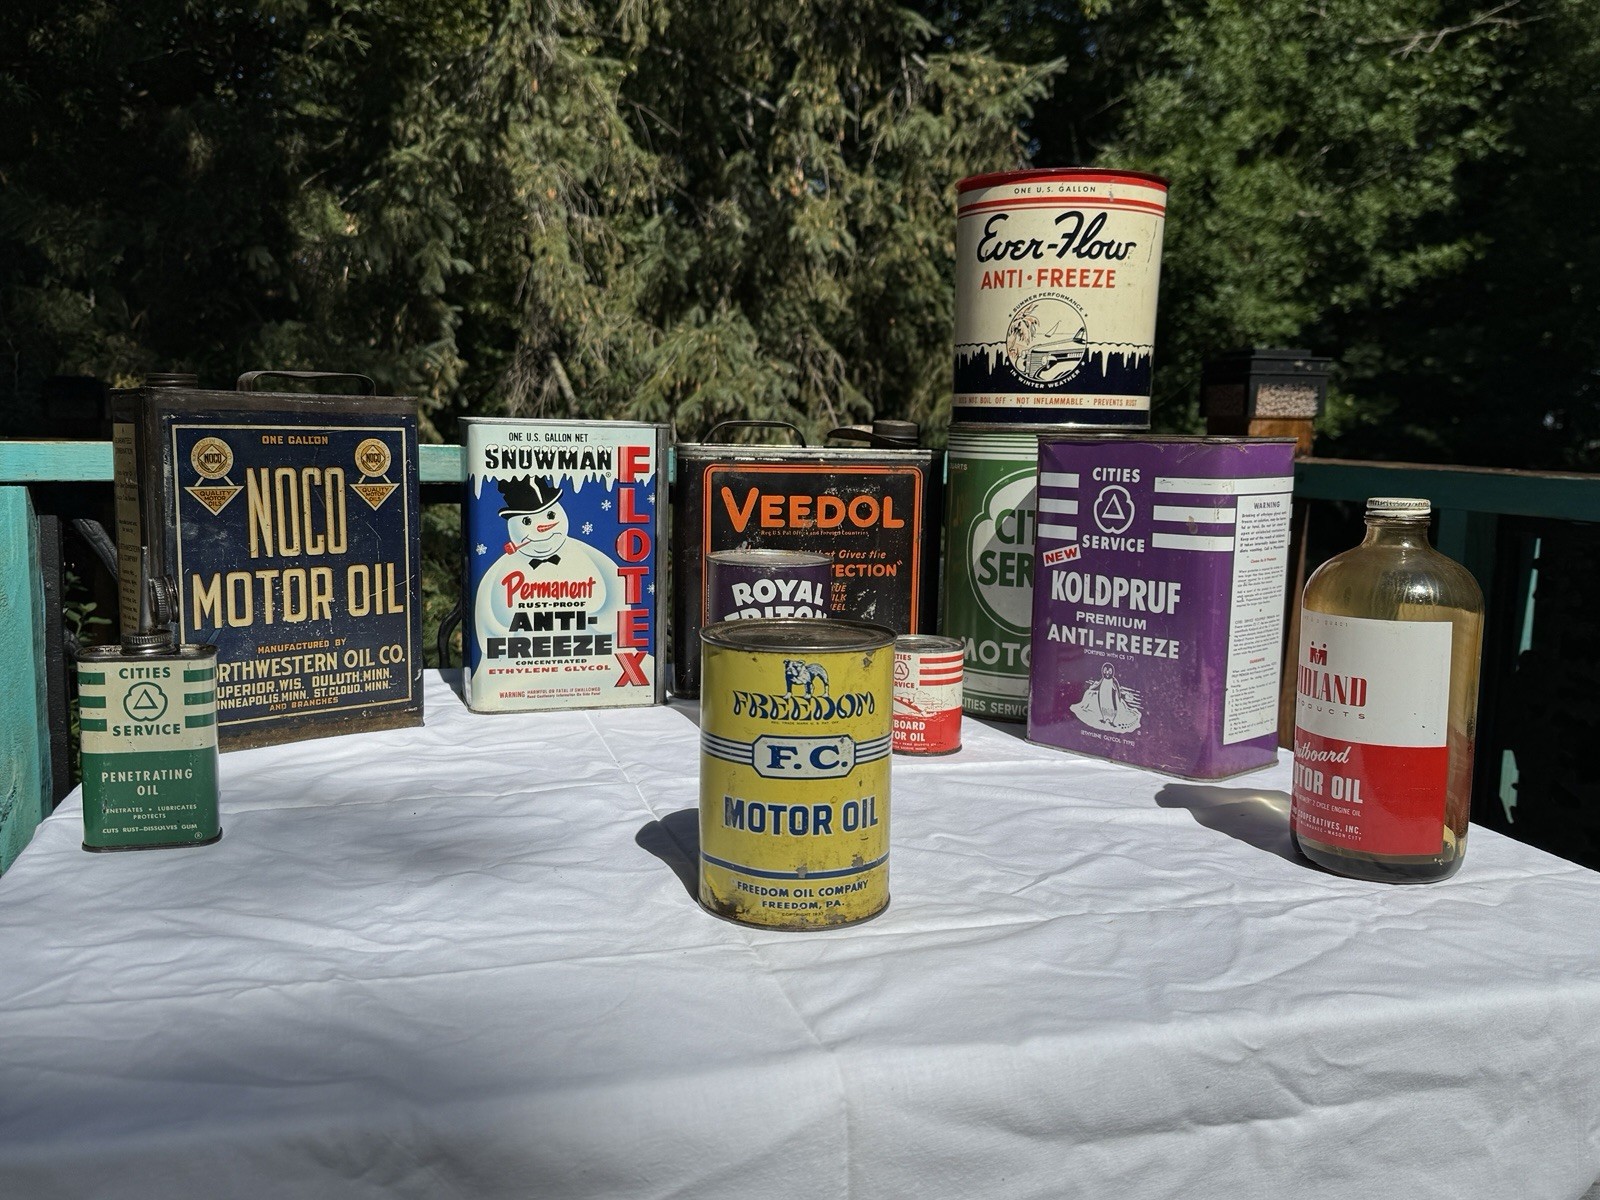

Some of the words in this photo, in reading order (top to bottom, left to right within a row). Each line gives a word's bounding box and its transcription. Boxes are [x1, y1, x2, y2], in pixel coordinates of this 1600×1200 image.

[1014, 186, 1032, 195] ONE
[1059, 185, 1096, 193] GALLON
[977, 210, 1137, 264] Ever-Flow
[1012, 294, 1038, 312] SUMMER
[1038, 292, 1084, 312] PERFORMANCE
[1009, 368, 1017, 377] IN
[1018, 376, 1045, 389] WINTER
[1047, 369, 1081, 389] WEATHER
[995, 396, 1006, 405] OFF
[1015, 396, 1029, 405] NOT
[1033, 397, 1083, 405] INFLAMMABLE
[1093, 398, 1123, 407] PREVENTS
[262, 435, 284, 445] ONE
[287, 435, 329, 446] GALLON
[508, 432, 523, 441] ONE
[526, 433, 541, 442] U.S.
[544, 433, 572, 442] GALLON
[574, 433, 589, 443] NET
[204, 453, 222, 464] NOCO
[485, 444, 612, 470] SNOWMAN
[1092, 467, 1141, 483] CITIES
[246, 466, 348, 559] NOCO
[721, 486, 905, 533] VEEDOL
[1253, 501, 1281, 510] WARNING
[995, 508, 1036, 545] CIT
[1082, 534, 1145, 553] SERVICE
[839, 549, 867, 559] Gives
[869, 549, 887, 559] the
[1045, 547, 1078, 564] NEW
[614, 446, 652, 688] FLOTEX
[832, 559, 902, 578] ECTION"
[192, 566, 335, 631] MOTOR
[347, 562, 404, 617] OIL
[501, 570, 597, 608] Permanent
[731, 578, 824, 607] ROYAL
[1051, 569, 1182, 615] KOLDPRUF
[517, 601, 587, 609] RUST-PROOF
[508, 611, 598, 632] ANTI-
[1076, 611, 1147, 630] PREMIUM
[257, 640, 330, 654] MANUFACTURED
[334, 637, 347, 647] BY
[487, 634, 613, 660] FREEZE
[1047, 623, 1180, 660] ANTI-FREEZE
[895, 653, 912, 661] TIES
[961, 636, 1032, 667] MOTO
[216, 651, 338, 684] RTHWESTERN
[343, 647, 376, 669] OIL
[378, 643, 406, 665] CO.
[488, 667, 559, 675] ETHYLENE
[564, 665, 611, 673] GLYCOL
[515, 658, 588, 666] CONCENTRATED
[118, 666, 171, 680] CITIES
[893, 681, 915, 689] RVICE
[1298, 664, 1367, 707] IDLAND
[500, 690, 525, 699] WARNING
[269, 702, 288, 712] AND
[291, 696, 339, 709] BRANCHES
[733, 690, 875, 721] FREEDOM
[990, 701, 1029, 717] SERVIC
[1298, 697, 1365, 720] ODUCTS
[112, 723, 181, 737] SERVICE
[892, 719, 926, 730] BOARD
[909, 732, 926, 742] OIL
[1103, 734, 1122, 744] GLYCOL
[101, 768, 193, 783] PENETRATING
[1294, 760, 1324, 796] OTOR
[1331, 775, 1364, 804] OIL
[136, 784, 159, 796] OIL
[104, 806, 143, 815] ENETRATES
[157, 803, 197, 812] LUBRICATES
[132, 813, 167, 821] PROTECTS
[723, 796, 834, 837] MOTOR
[842, 795, 879, 833] OIL
[1316, 801, 1331, 811] CYCLE
[1331, 805, 1351, 815] ENGINE
[1352, 809, 1362, 817] OIL
[1327, 830, 1346, 839] MASON
[1347, 834, 1362, 842] CITY
[1345, 824, 1362, 836] INC.
[737, 881, 789, 898] FREEDOM
[793, 889, 814, 898] OIL
[818, 880, 869, 897] COMPANY
[762, 900, 822, 910] FREEDOM,
[826, 900, 845, 908] PA.
